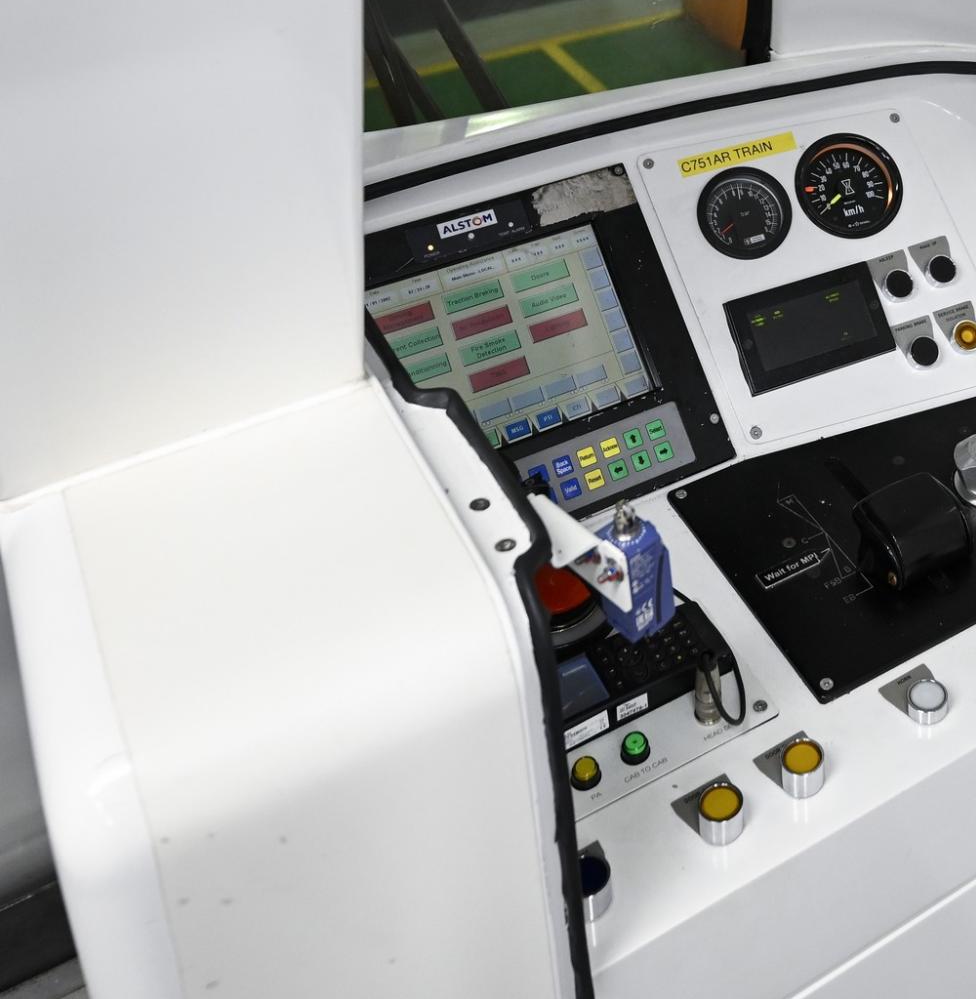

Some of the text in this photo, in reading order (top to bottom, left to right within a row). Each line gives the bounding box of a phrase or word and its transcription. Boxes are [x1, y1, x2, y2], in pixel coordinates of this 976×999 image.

[681, 141, 773, 173] C751AR TRAIN
[833, 162, 840, 170] 50
[820, 175, 827, 183] 30
[865, 190, 875, 198] 100
[843, 204, 864, 217] km/h
[443, 213, 493, 235] ALSTOM
[531, 271, 550, 281] Doors
[448, 293, 474, 306] Traction
[531, 292, 567, 308] Audio Video
[894, 318, 927, 332] PARKING BRAKE
[408, 333, 441, 349] Collection
[471, 337, 505, 353] Fire Smoke
[476, 345, 508, 360] Detection
[510, 425, 524, 434] MSG
[649, 425, 663, 435] Select
[579, 452, 595, 462] Return
[556, 459, 569, 469] Back
[556, 465, 573, 475] Space
[588, 474, 602, 484] Reset
[564, 484, 577, 493] Valid
[764, 567, 786, 581] Wait
[786, 561, 800, 572] for
[842, 593, 857, 604] EB
[897, 675, 912, 685] HORN
[703, 728, 722, 741] HEAD
[624, 757, 668, 783] CAB TO CAB
[590, 791, 602, 801] PA
